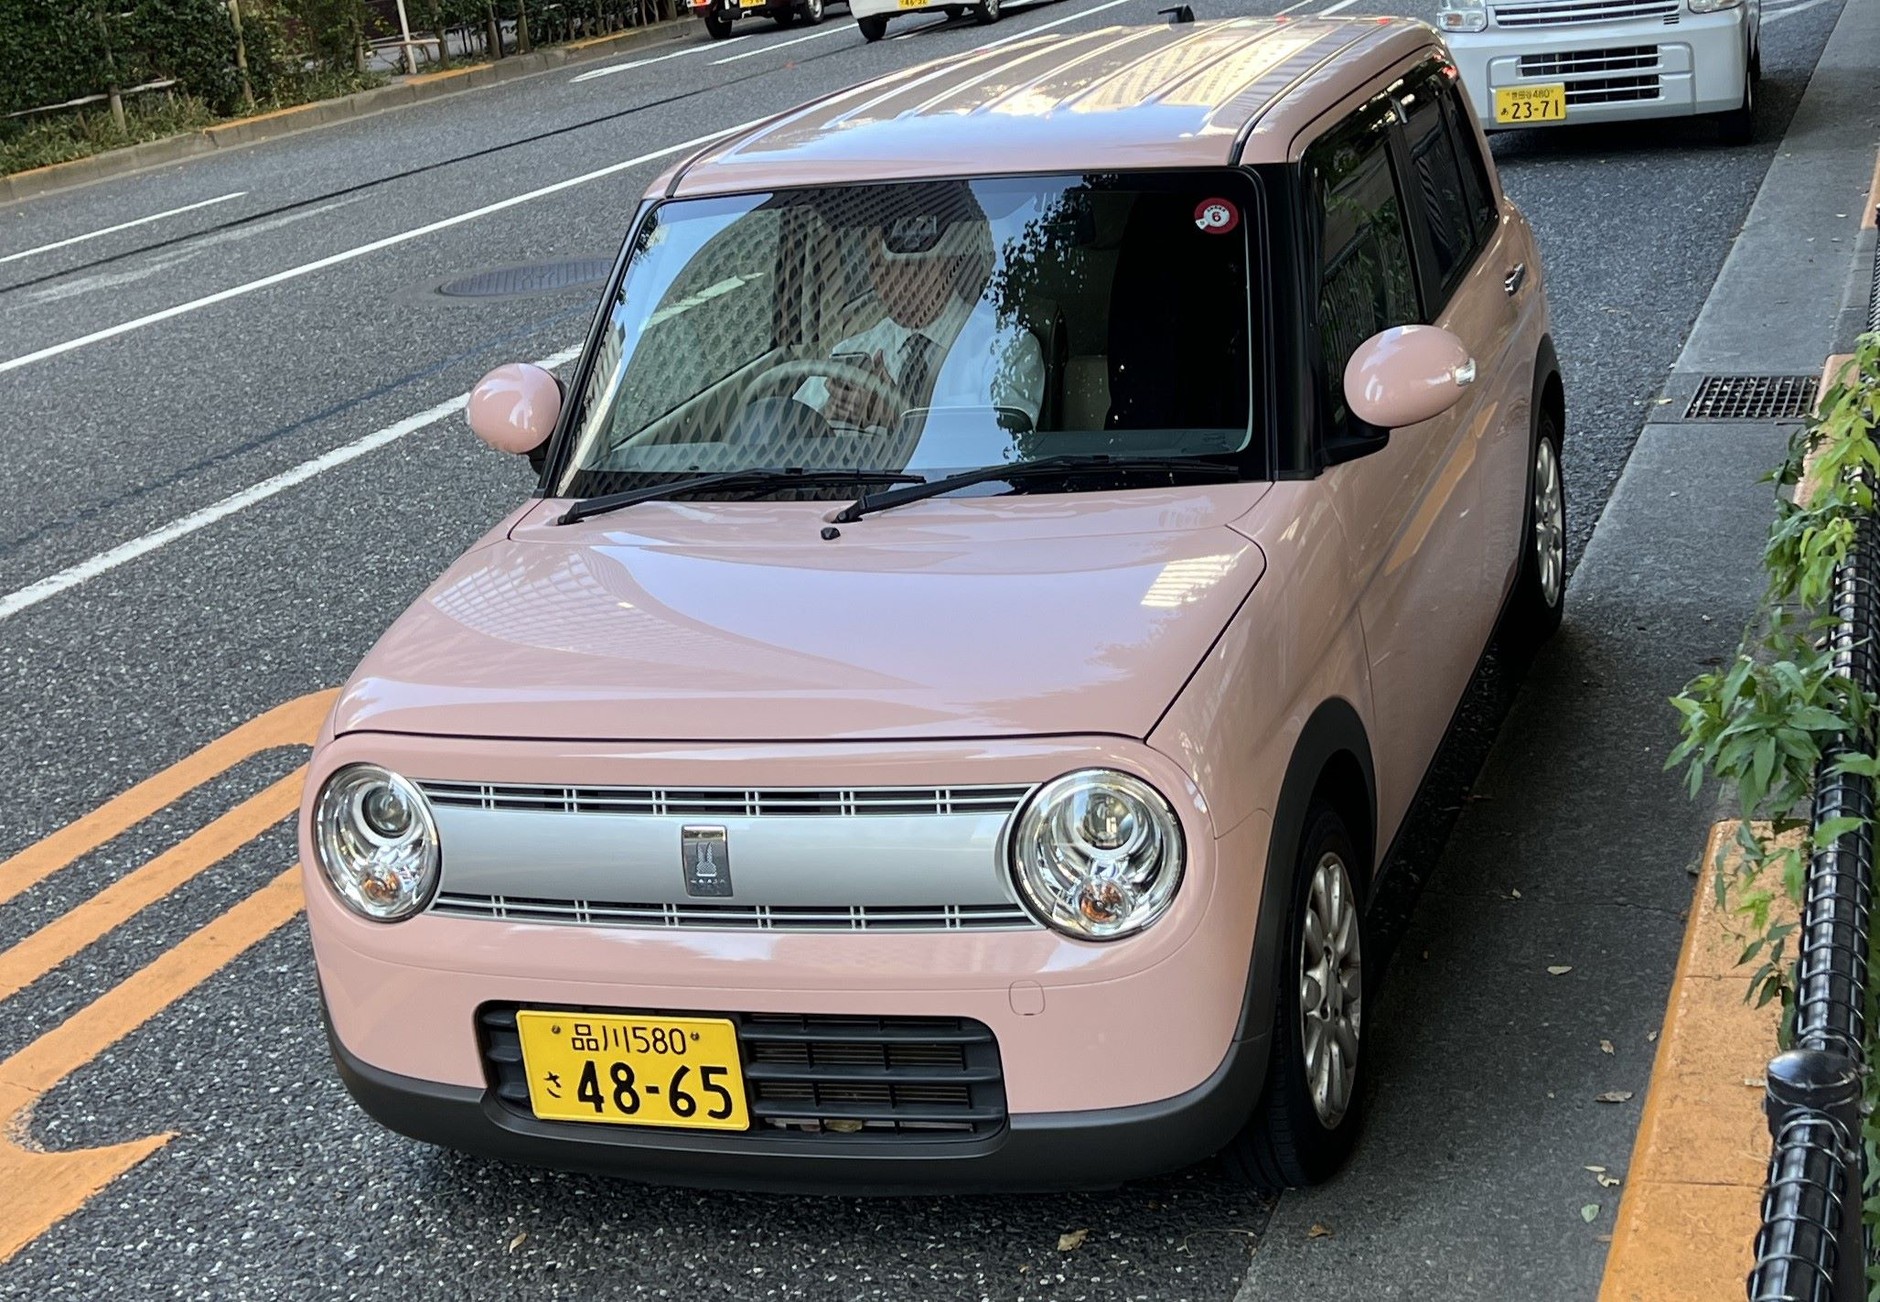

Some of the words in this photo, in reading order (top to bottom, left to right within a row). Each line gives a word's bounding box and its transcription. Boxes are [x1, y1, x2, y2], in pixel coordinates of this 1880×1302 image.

[1511, 99, 1559, 119] 23-71
[1212, 211, 1221, 222] 6
[572, 1023, 687, 1055] 品川580
[544, 1071, 562, 1098] さ
[577, 1060, 733, 1119] 48-65
